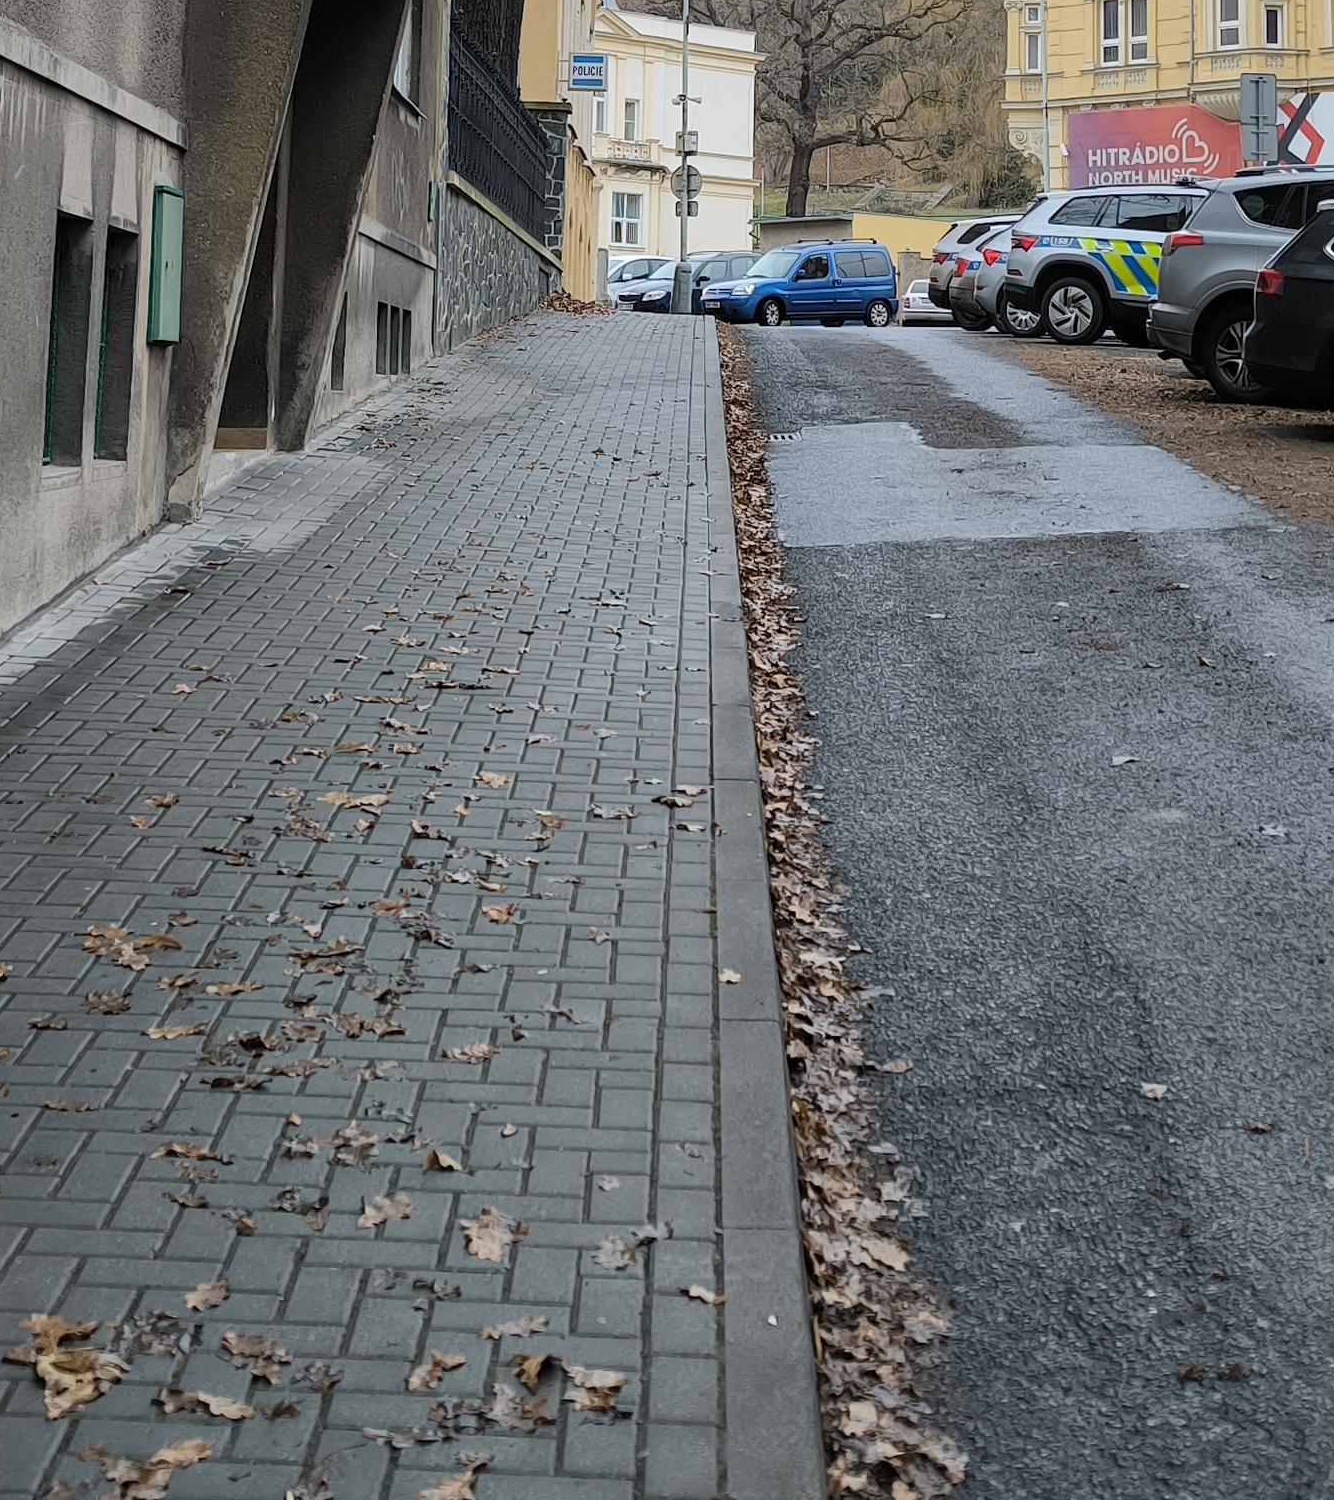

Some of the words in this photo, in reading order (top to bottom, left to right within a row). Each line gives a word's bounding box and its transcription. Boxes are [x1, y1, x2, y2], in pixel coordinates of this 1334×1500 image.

[572, 65, 604, 77] POLICIE
[1088, 141, 1180, 167] HITRÁDIO
[1088, 169, 1143, 186] NORTH
